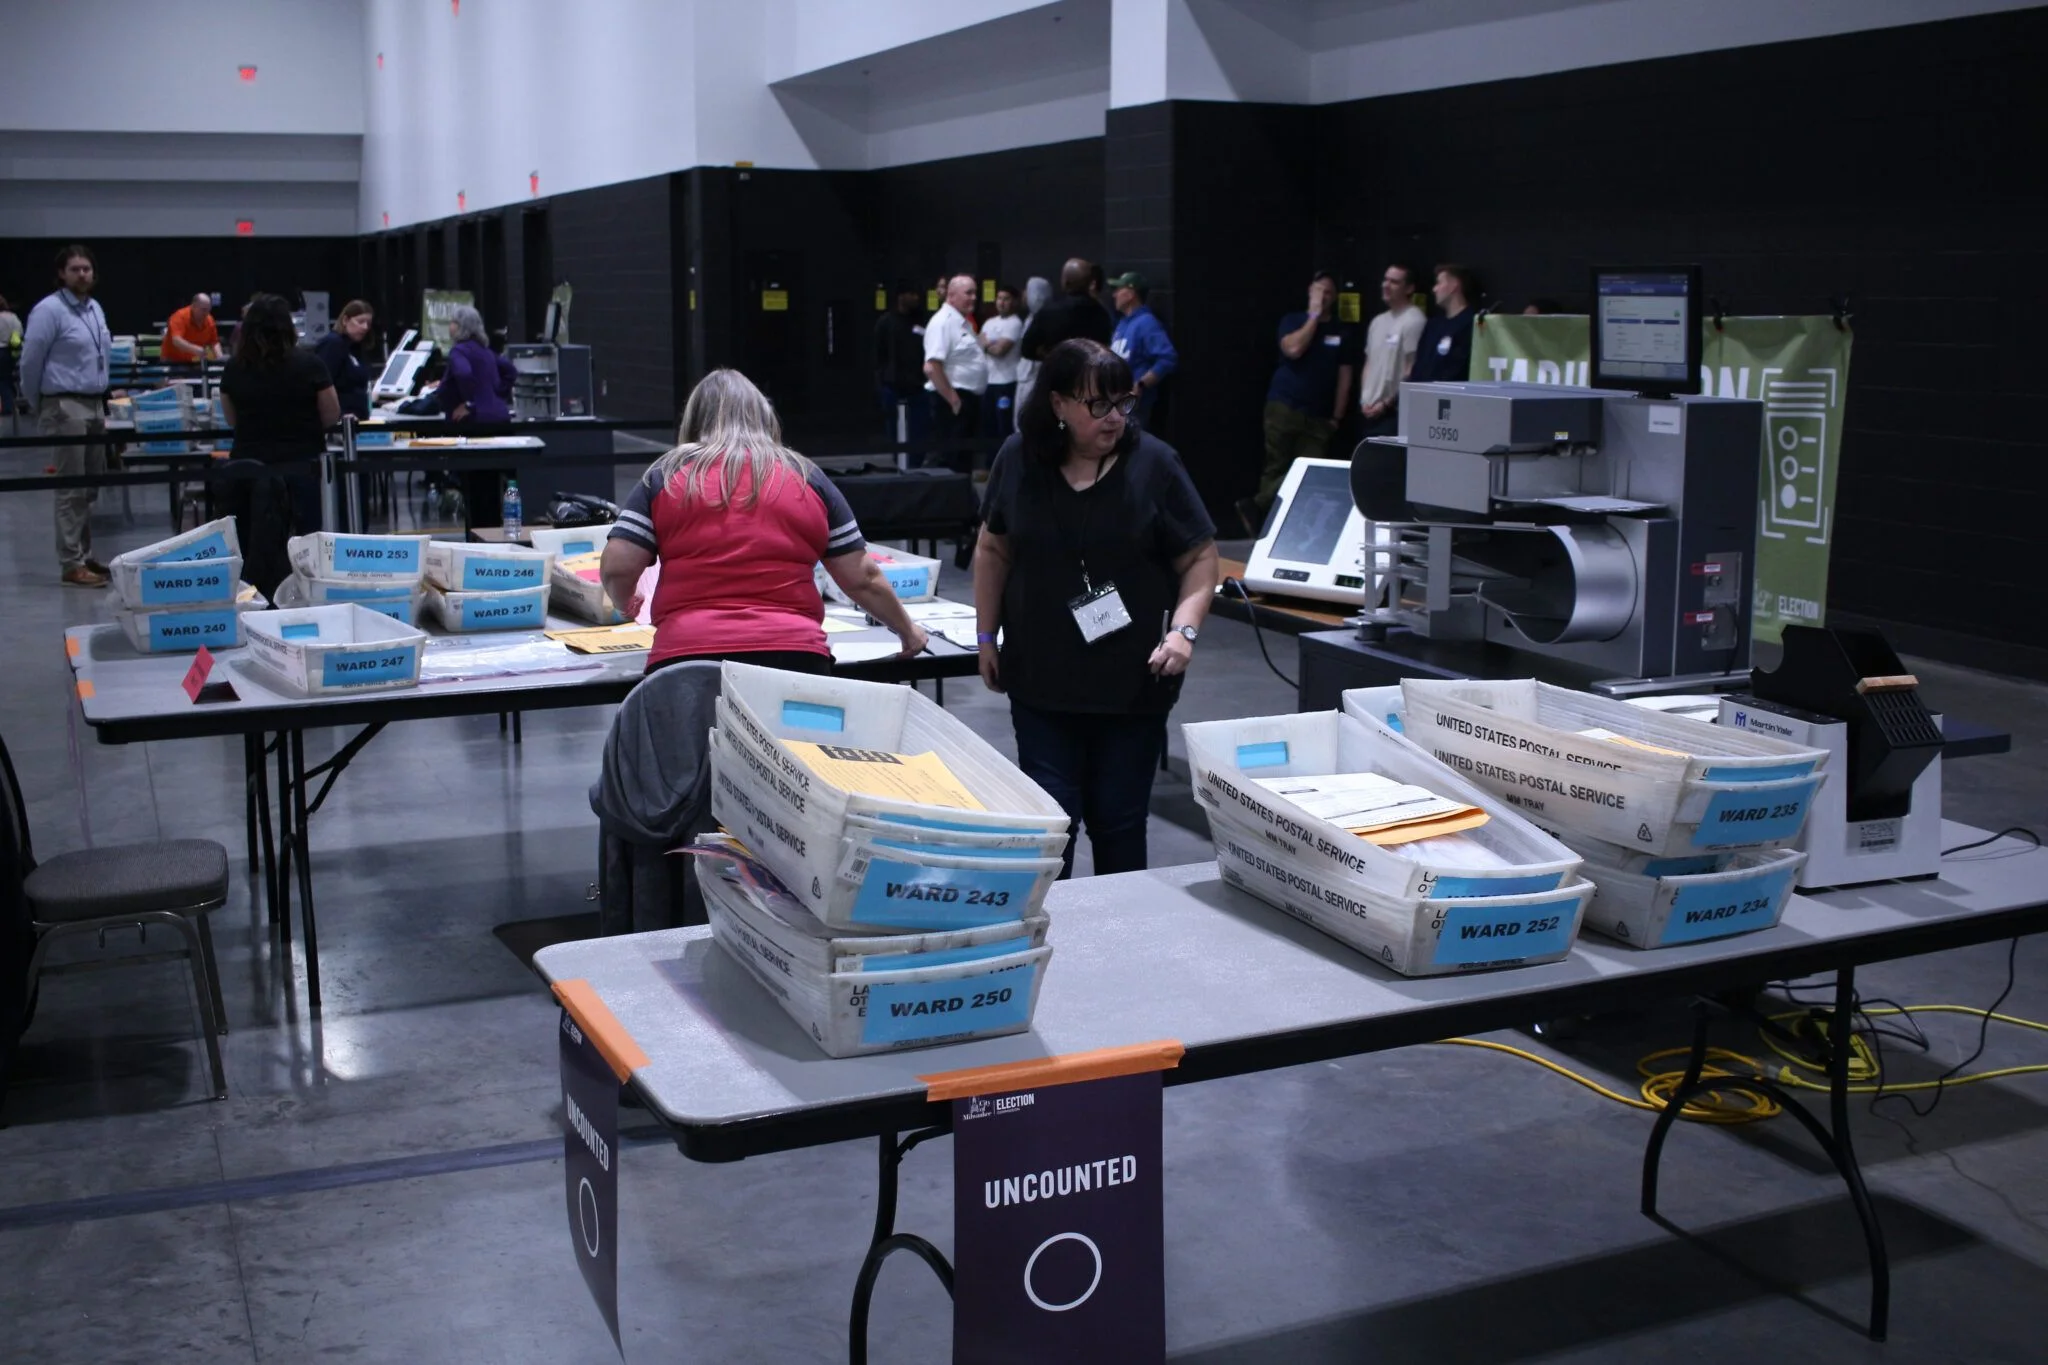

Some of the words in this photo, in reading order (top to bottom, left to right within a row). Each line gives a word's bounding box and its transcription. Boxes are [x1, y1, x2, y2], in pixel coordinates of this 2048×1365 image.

[1429, 426, 1458, 442] DS950
[346, 549, 383, 559] WARD
[387, 550, 409, 559] 253
[153, 578, 193, 589] WARD
[196, 576, 219, 587] 249
[475, 568, 511, 577] WARD
[474, 607, 509, 618] WARD
[512, 604, 534, 615] 237
[161, 626, 200, 637] WARD
[204, 623, 226, 633] 240
[336, 660, 377, 672] WARD
[381, 656, 404, 668] 247
[1436, 712, 1472, 736] UNITED
[1474, 725, 1517, 749] STATES
[1750, 718, 1776, 732] Martin
[1775, 725, 1793, 737] Yale
[782, 757, 810, 792] SERVICE
[1434, 749, 1473, 771] UNITED
[1475, 762, 1517, 785] STATES
[1519, 774, 1567, 796] POSTAL
[1569, 784, 1625, 810] SERVICE
[779, 778, 805, 814] SERVICE
[1523, 798, 1545, 811] TRAY
[1207, 770, 1239, 801] UNITED
[1239, 792, 1274, 824] STATES
[1275, 813, 1315, 848] POSTAL
[1316, 837, 1367, 875] SERVICE
[1718, 806, 1769, 823] WARD
[1769, 802, 1800, 819] 235
[775, 821, 806, 857] SERVICE
[1228, 841, 1256, 867] UNITED
[1255, 858, 1287, 884] STATES
[1288, 873, 1324, 901] POSTAL
[1324, 890, 1368, 920] SERVICE
[886, 881, 960, 903] WARD
[964, 890, 1010, 907] 243
[1685, 906, 1737, 924] WARD
[1739, 896, 1770, 914] 234
[1460, 922, 1521, 940] WARD
[1525, 916, 1560, 934] 252
[890, 997, 964, 1018] WARD
[970, 987, 1013, 1009] 250
[997, 1094, 1034, 1110] ELECTION
[566, 1092, 609, 1172] UNCOUNTED
[985, 1154, 1137, 1209] UNCOUNTED
